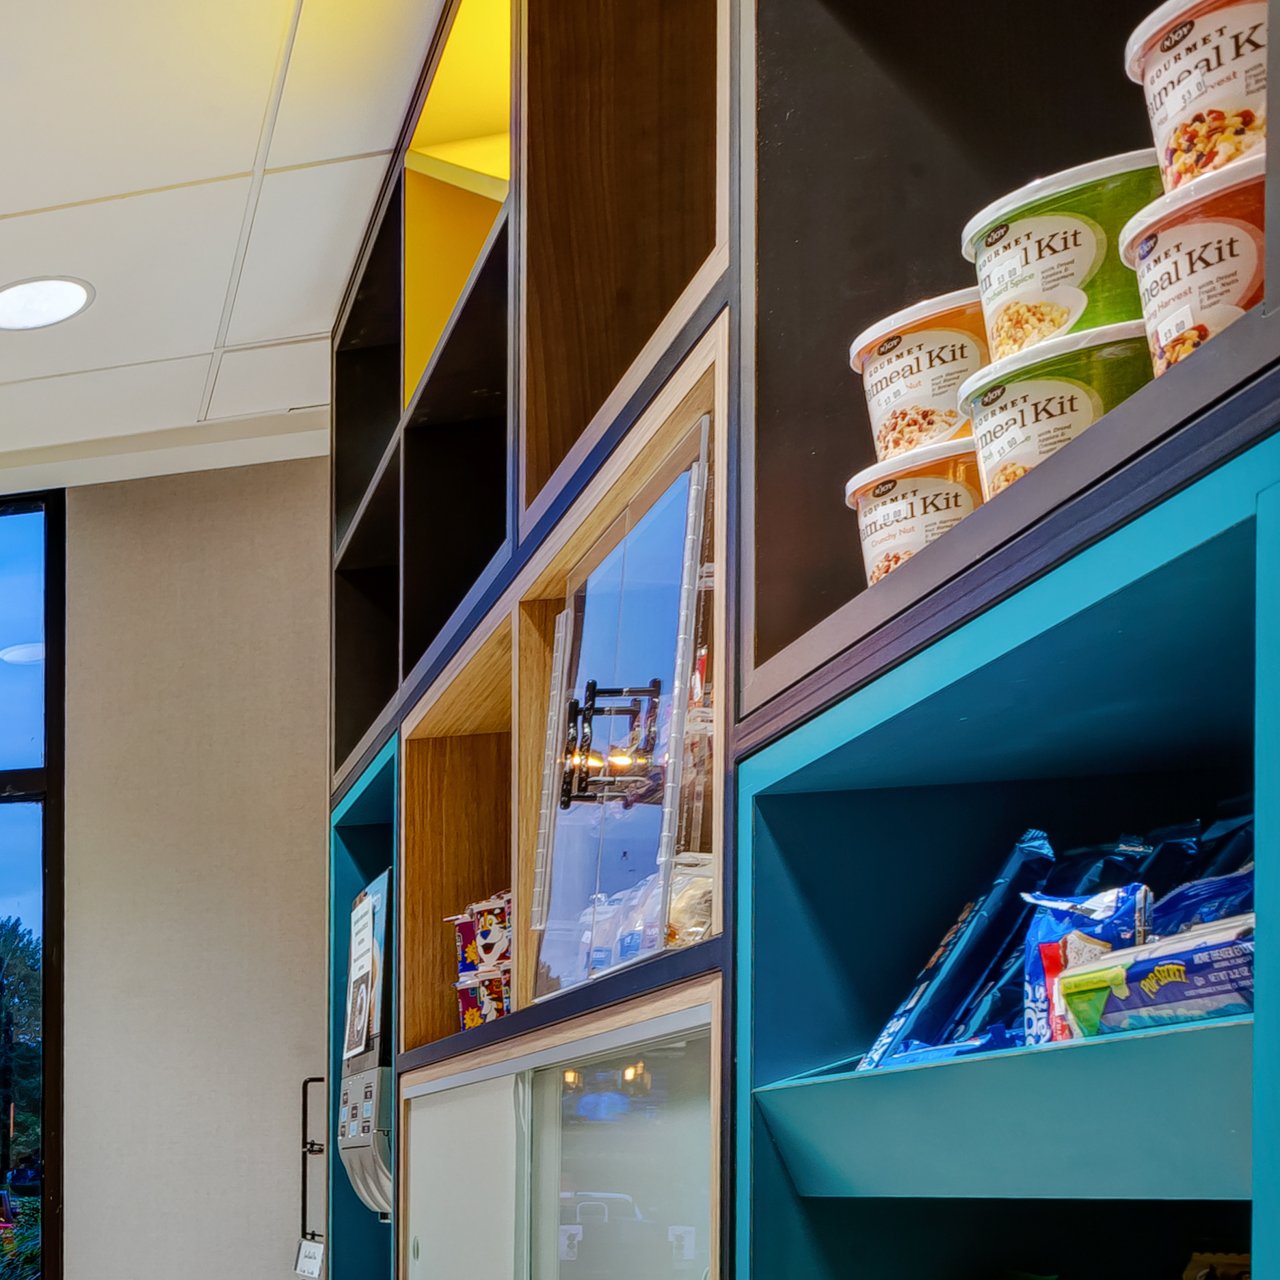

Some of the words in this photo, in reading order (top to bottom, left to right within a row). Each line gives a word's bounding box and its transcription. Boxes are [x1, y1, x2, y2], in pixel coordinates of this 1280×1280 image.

[1035, 229, 1082, 261] Kit
[1185, 236, 1240, 276] Kit
[926, 343, 968, 370] Kit
[1031, 395, 1079, 424] Kit
[921, 492, 962, 516] Kit
